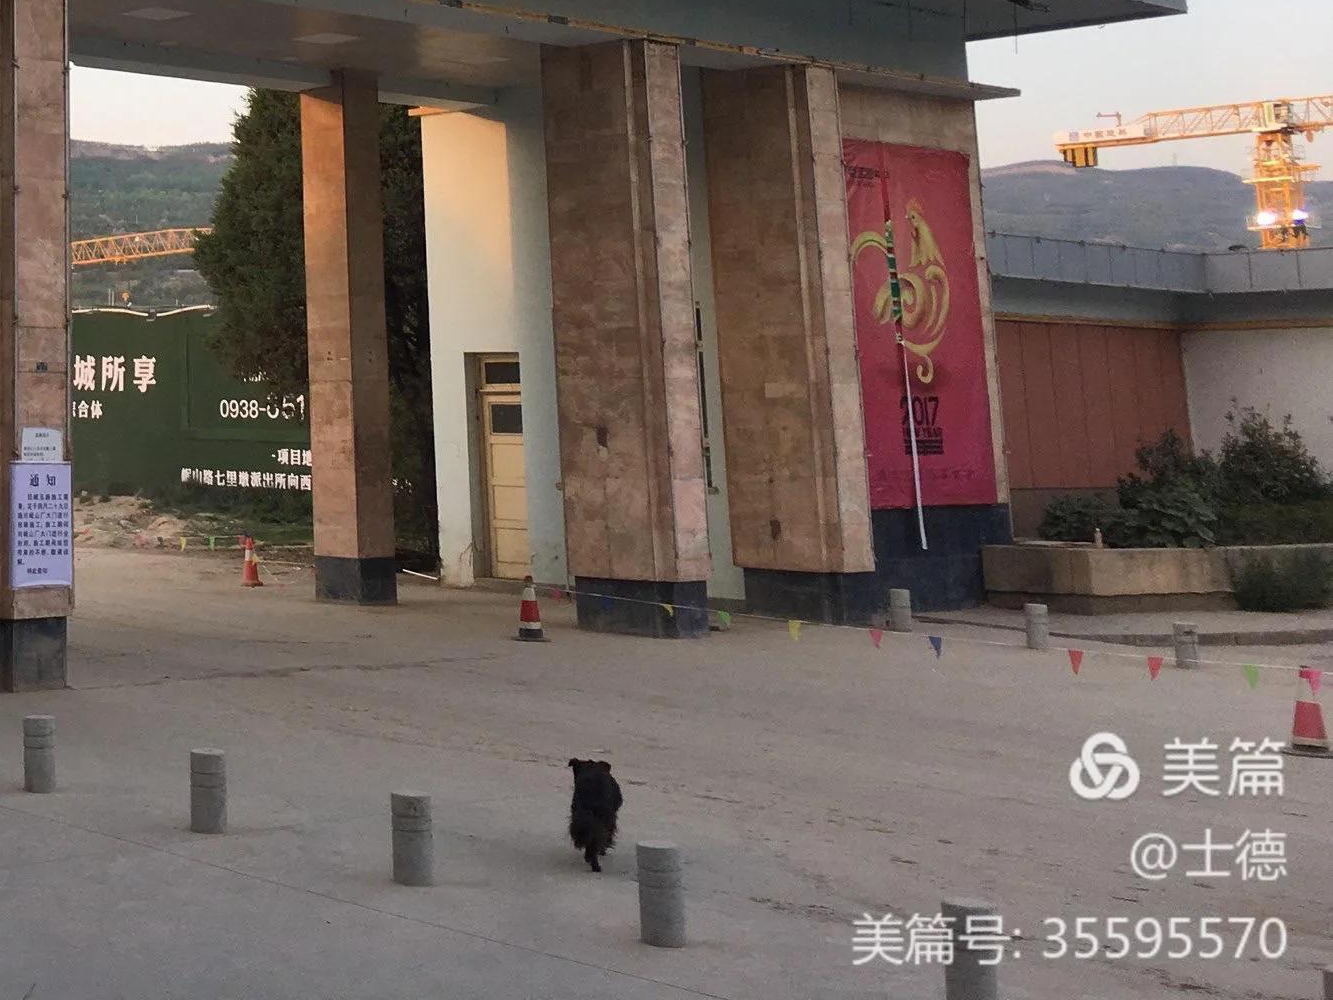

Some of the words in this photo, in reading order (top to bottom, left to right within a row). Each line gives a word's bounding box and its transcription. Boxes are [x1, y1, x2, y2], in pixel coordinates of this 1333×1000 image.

[72, 354, 157, 393] 城所享
[72, 400, 103, 419] 合体
